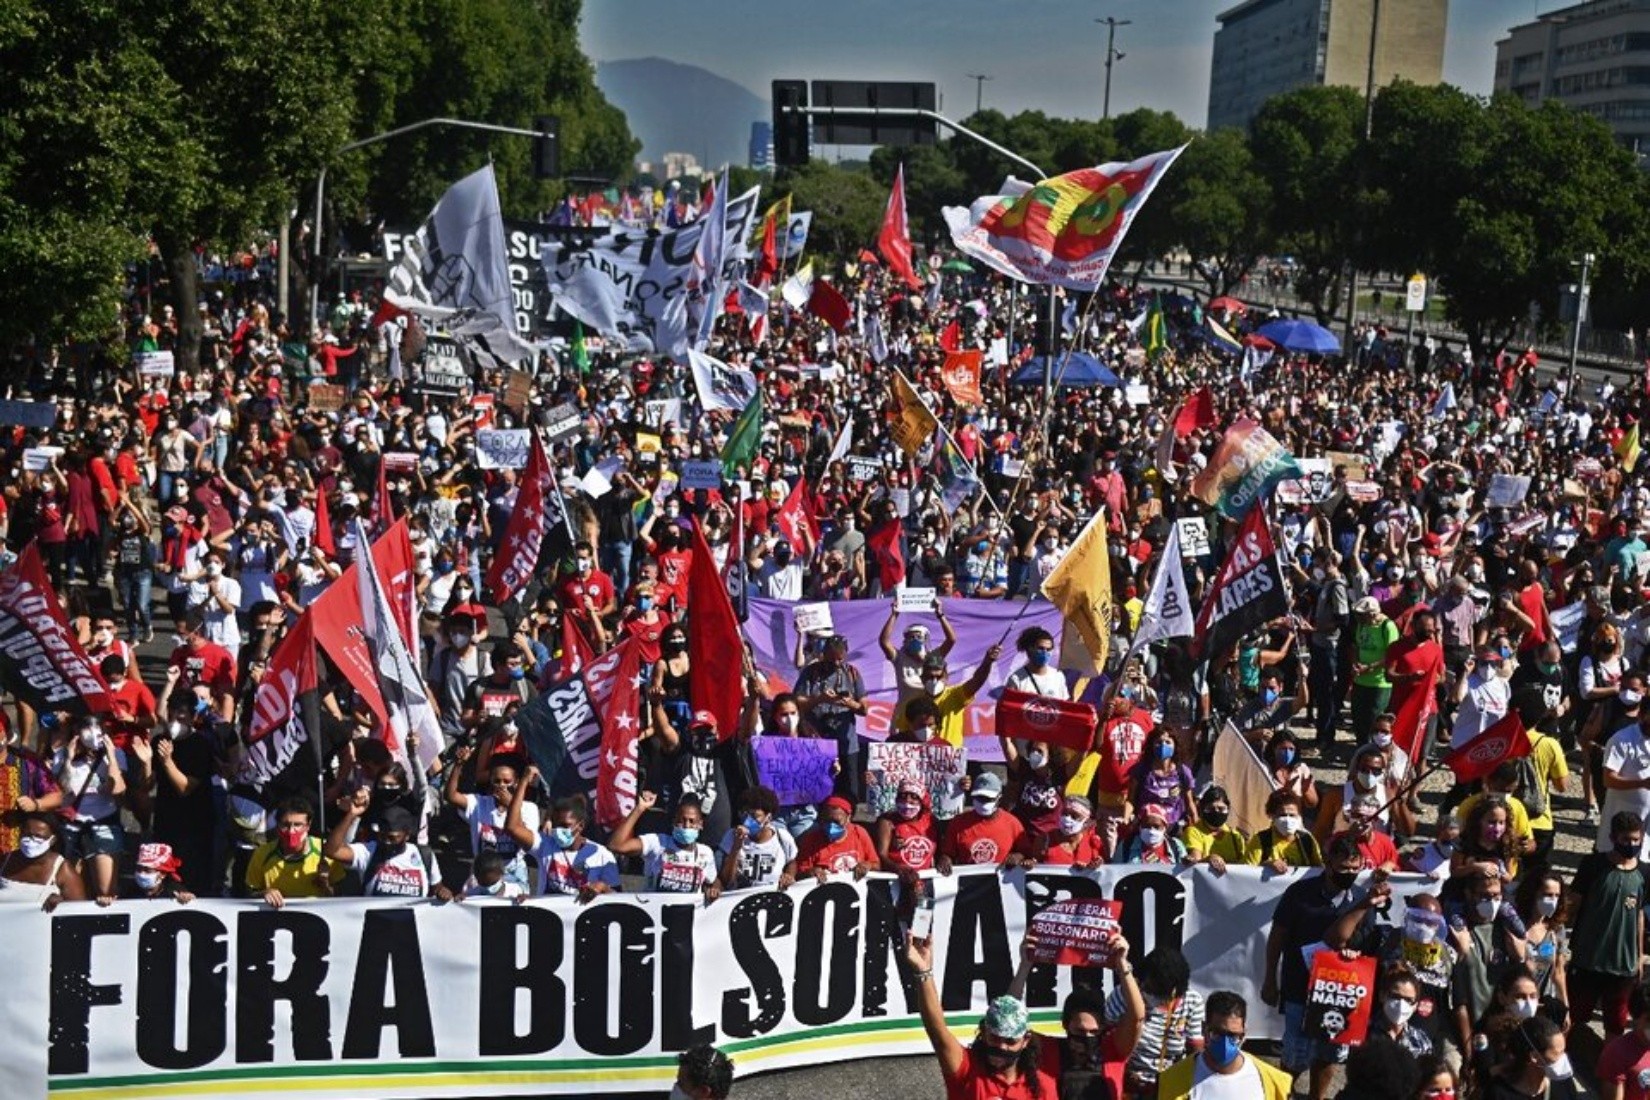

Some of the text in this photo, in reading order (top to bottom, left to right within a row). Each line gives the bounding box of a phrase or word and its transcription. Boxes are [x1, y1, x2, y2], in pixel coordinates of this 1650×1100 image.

[377, 881, 420, 896] POPULARES
[1036, 922, 1108, 941] BOLSONARO
[1316, 966, 1360, 983] FORA
[48, 907, 437, 1076] FORA
[1314, 978, 1367, 998] BOLSO
[1311, 991, 1357, 1009] NARO
